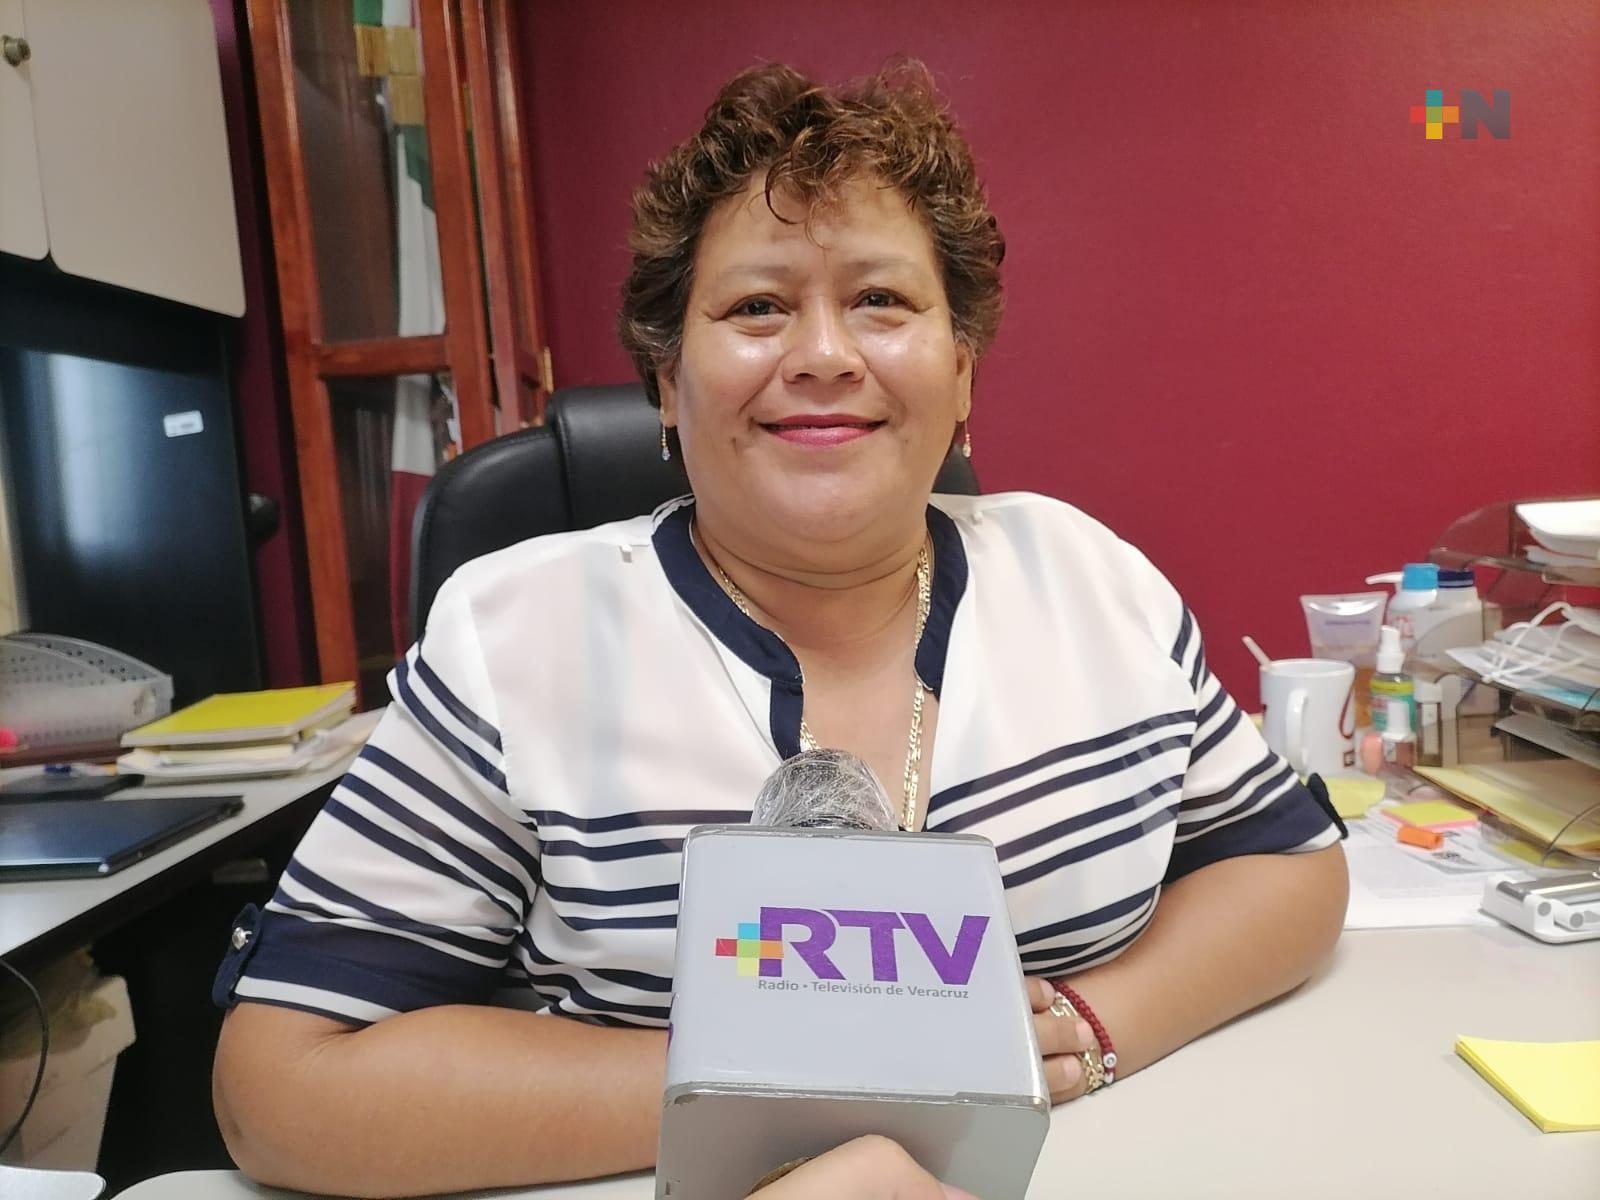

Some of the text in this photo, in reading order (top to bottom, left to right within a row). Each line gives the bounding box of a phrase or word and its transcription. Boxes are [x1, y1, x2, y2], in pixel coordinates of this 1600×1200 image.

[759, 906, 990, 985] RTV
[758, 980, 969, 999] Radio Televisión de Veracruz
